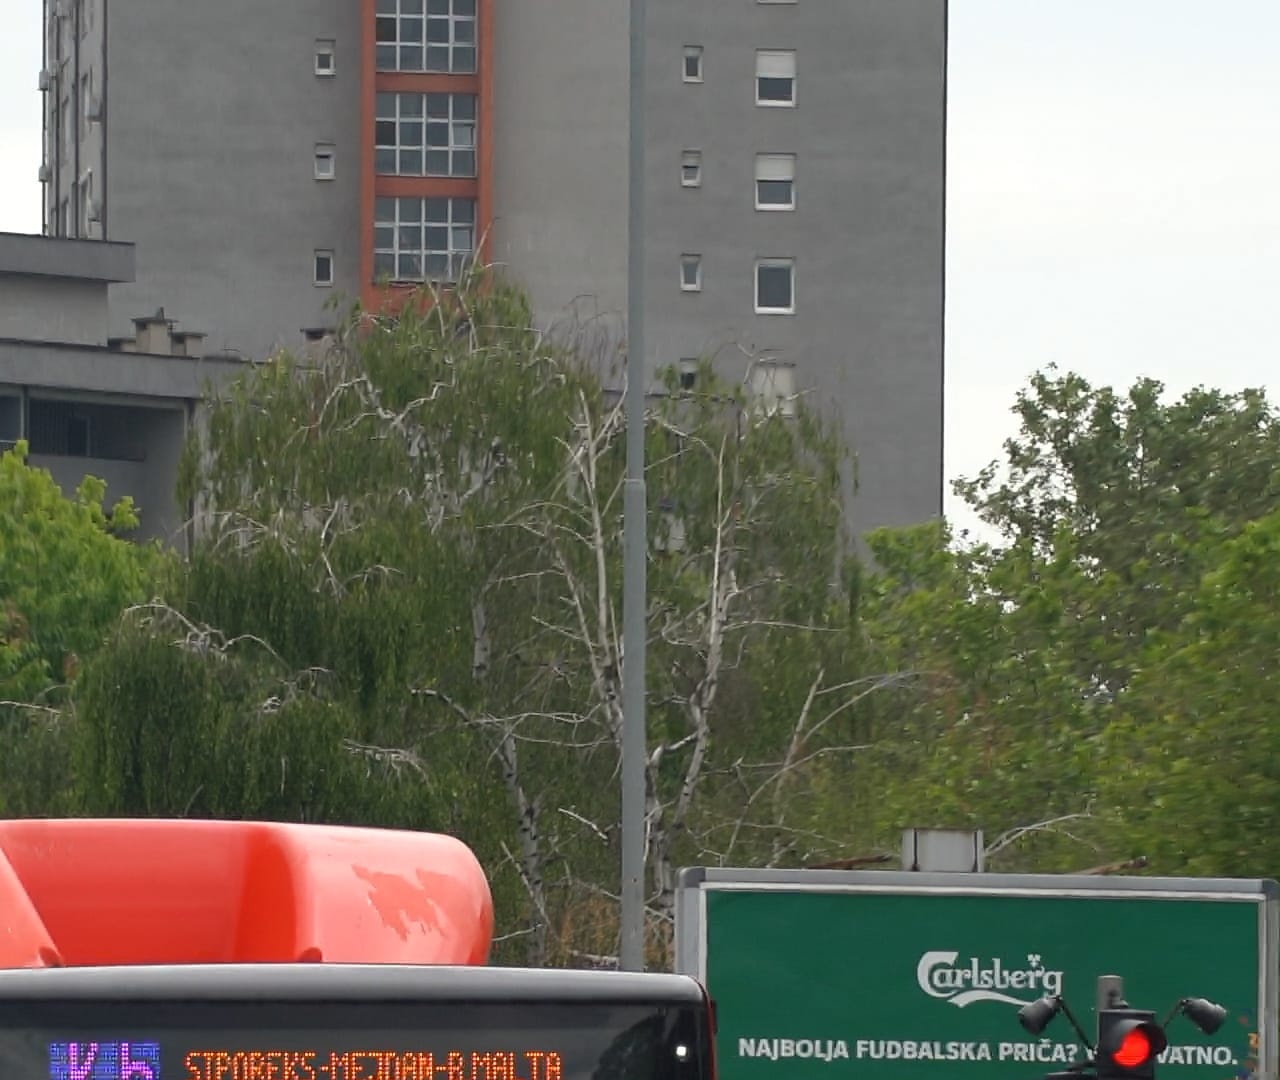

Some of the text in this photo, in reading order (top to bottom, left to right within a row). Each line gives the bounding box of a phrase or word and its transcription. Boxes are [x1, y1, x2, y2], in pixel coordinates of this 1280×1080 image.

[917, 950, 1064, 1007] Carlsberg
[739, 1037, 850, 1063] NAJBOLJA
[856, 1039, 992, 1062] FUDBALSKA
[998, 1037, 1078, 1063] PRIČA?
